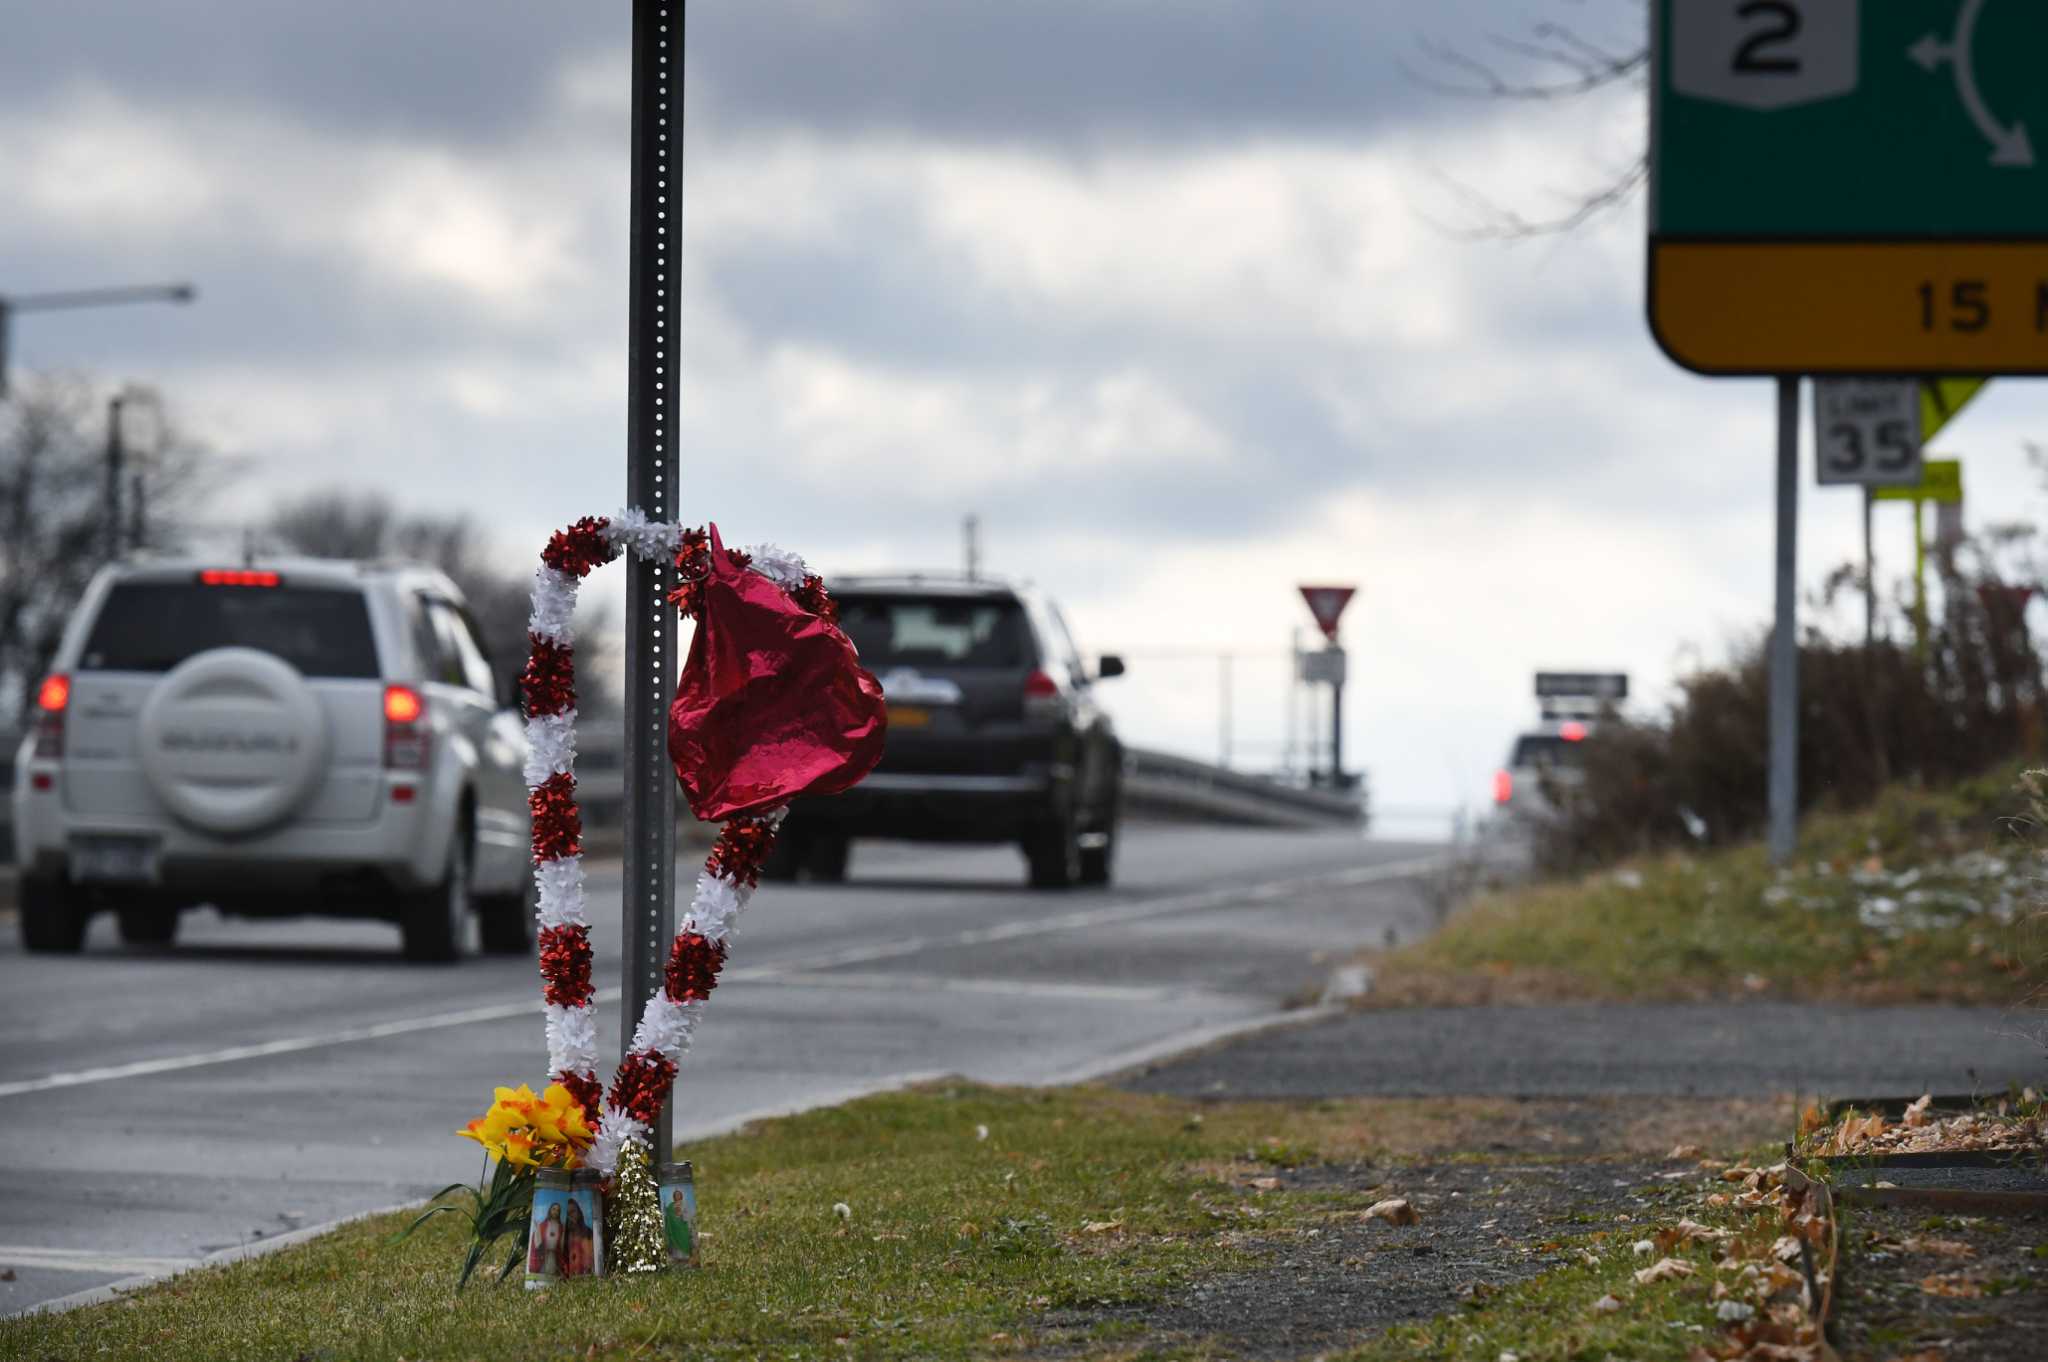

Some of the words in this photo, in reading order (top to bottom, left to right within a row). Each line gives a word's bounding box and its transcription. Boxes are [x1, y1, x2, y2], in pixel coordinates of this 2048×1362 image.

[1732, 0, 1801, 74] 2
[1918, 280, 1990, 332] 15
[1828, 420, 1916, 473] 35
